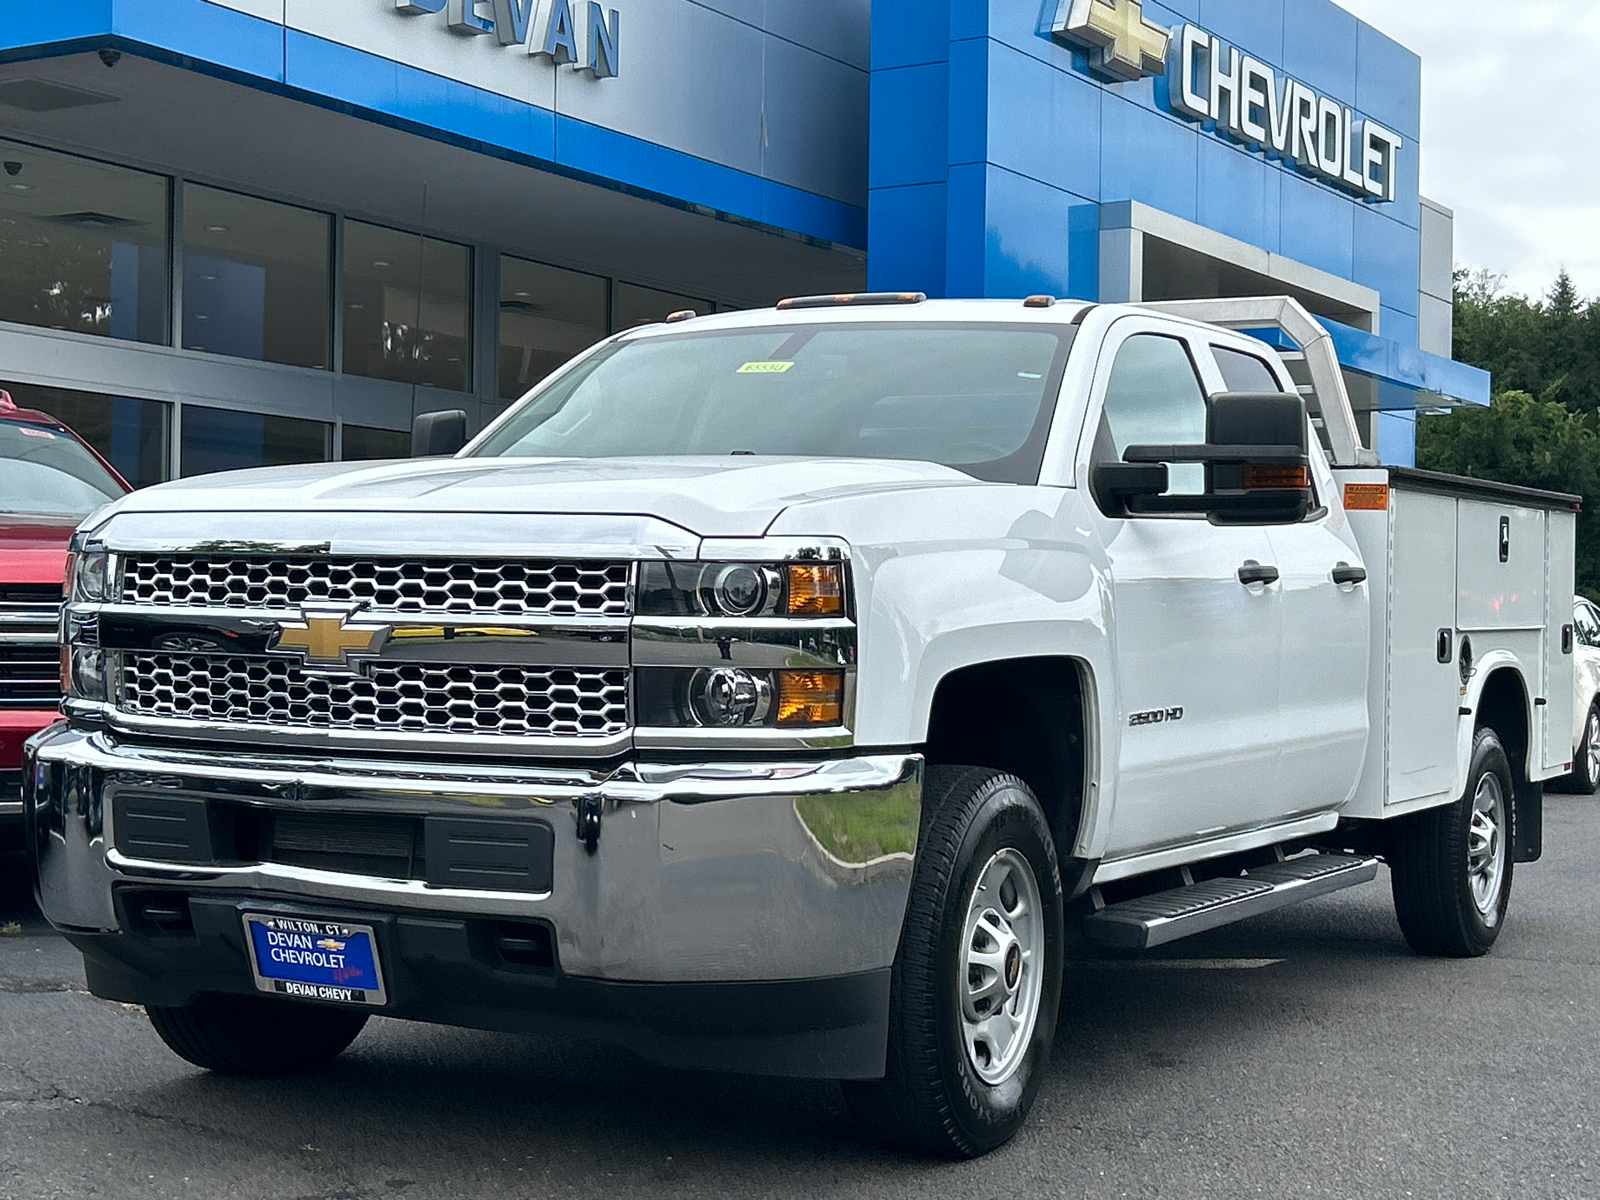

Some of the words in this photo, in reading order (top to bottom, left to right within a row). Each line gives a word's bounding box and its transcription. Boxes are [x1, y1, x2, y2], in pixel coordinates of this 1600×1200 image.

[396, 0, 619, 78] VAN
[1180, 22, 1403, 202] CHEVROLET
[1129, 710, 1164, 726] 2500
[1165, 707, 1183, 721] HD
[276, 919, 323, 934] WILTON,
[325, 924, 340, 935] CT
[267, 931, 313, 949] DEVAN
[271, 948, 345, 968] CHEVROLET
[285, 982, 318, 997] DEVAN
[318, 987, 352, 1000] CHEVY
